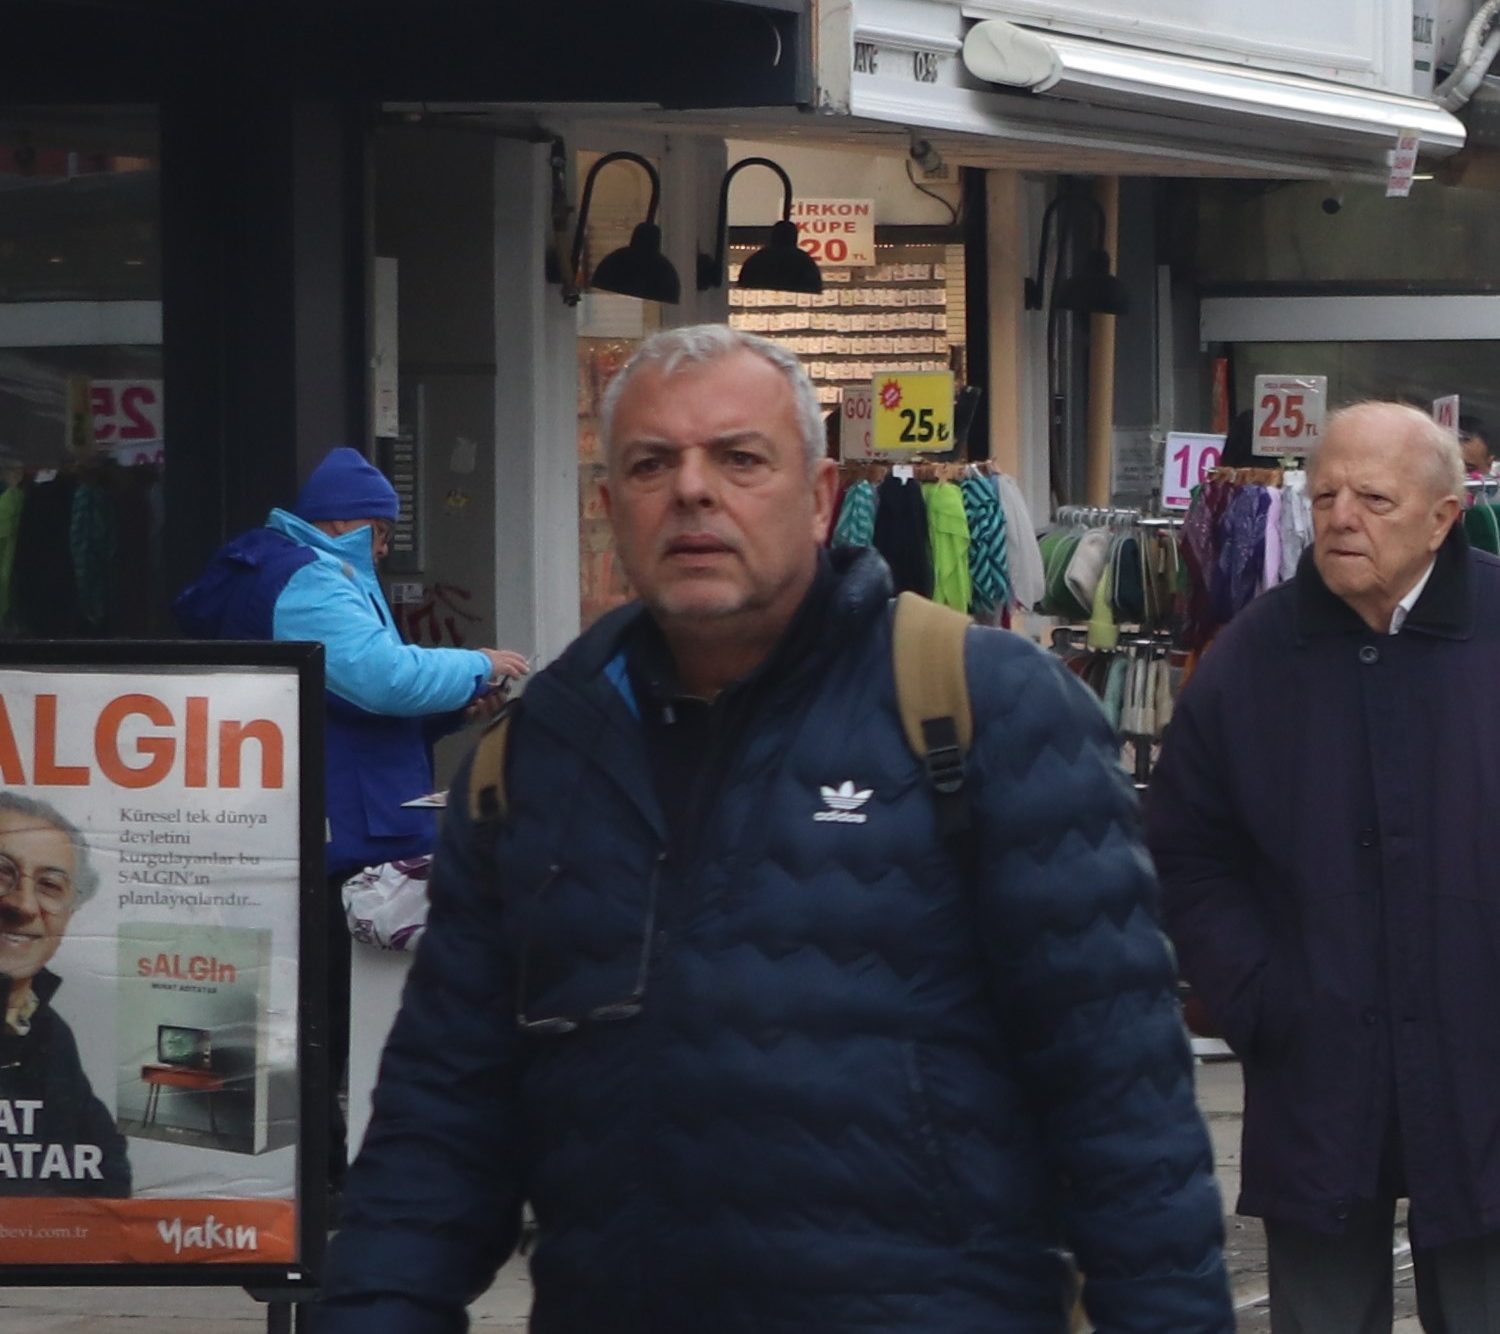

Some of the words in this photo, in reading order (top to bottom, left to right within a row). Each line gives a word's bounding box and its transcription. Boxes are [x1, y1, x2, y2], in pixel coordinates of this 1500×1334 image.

[798, 219, 857, 234] KÜPE
[799, 238, 848, 263] 20
[852, 252, 868, 262] TL
[1259, 394, 1306, 438] 25
[1306, 423, 1319, 436] TL
[119, 807, 182, 824] Küresel
[187, 808, 210, 824] tek
[215, 808, 268, 826] dünya
[812, 809, 868, 824] adidas
[119, 829, 191, 844] devletini
[118, 850, 234, 870] kurgulayanlar
[239, 851, 261, 866] bu
